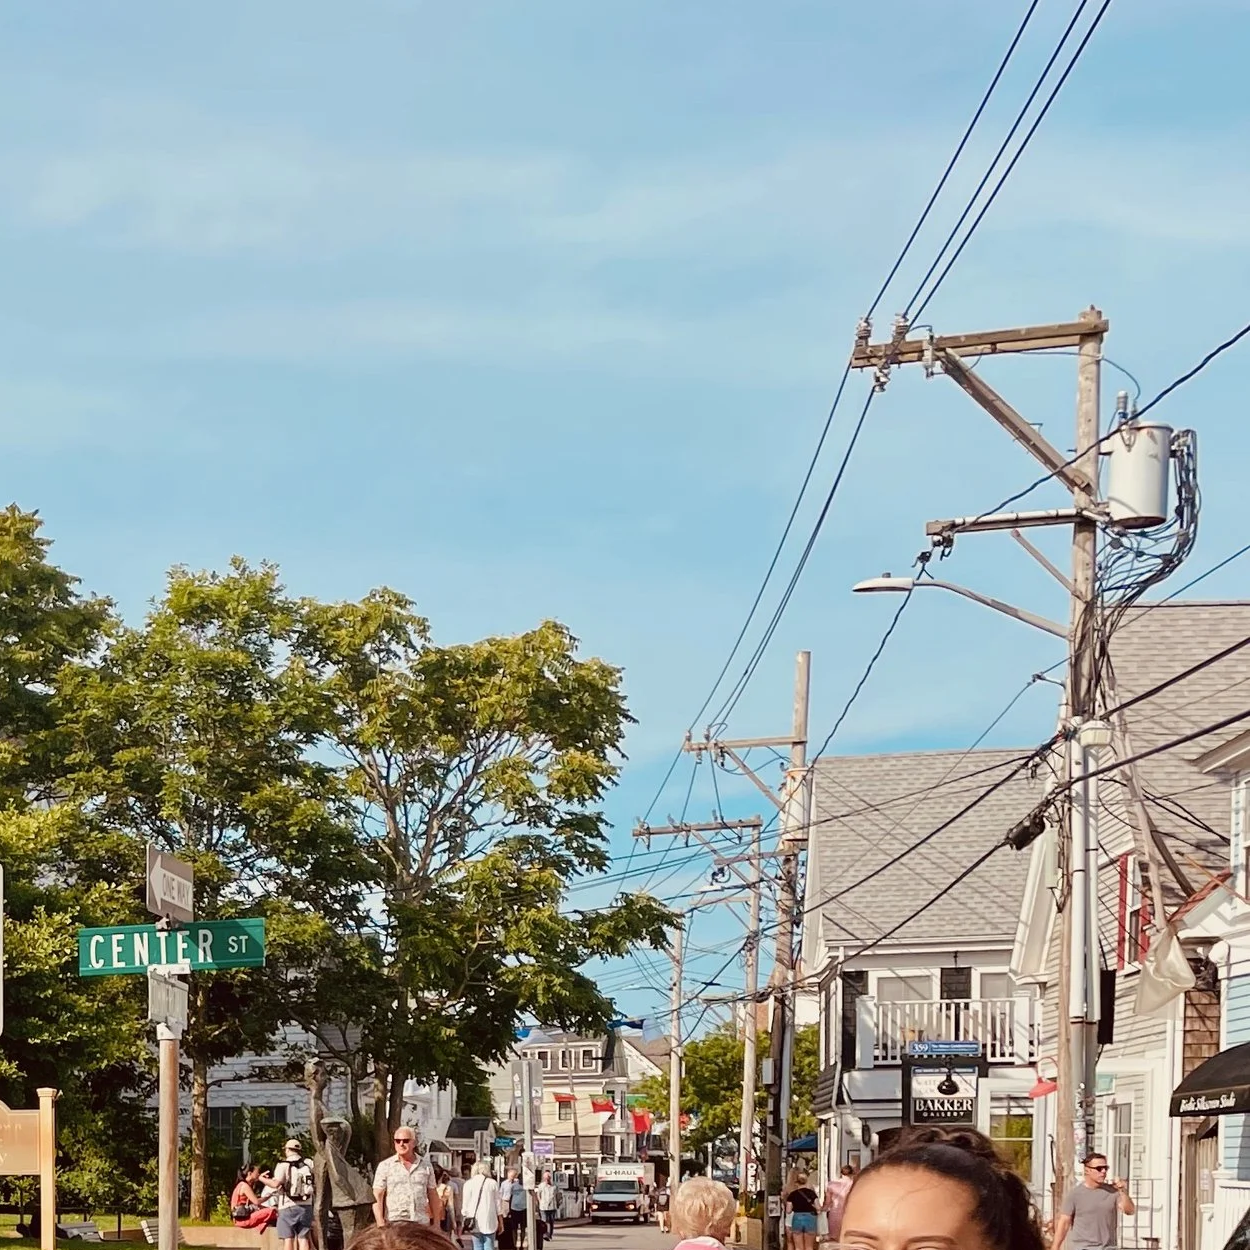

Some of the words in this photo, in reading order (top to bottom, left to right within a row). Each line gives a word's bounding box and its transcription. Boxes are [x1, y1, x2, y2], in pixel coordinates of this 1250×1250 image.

[163, 873, 175, 900] ONE
[177, 880, 191, 908] WAY
[89, 929, 213, 969] CENTER
[228, 935, 248, 954] ST
[913, 1043, 929, 1052] 359
[916, 1099, 973, 1111] BAKKER
